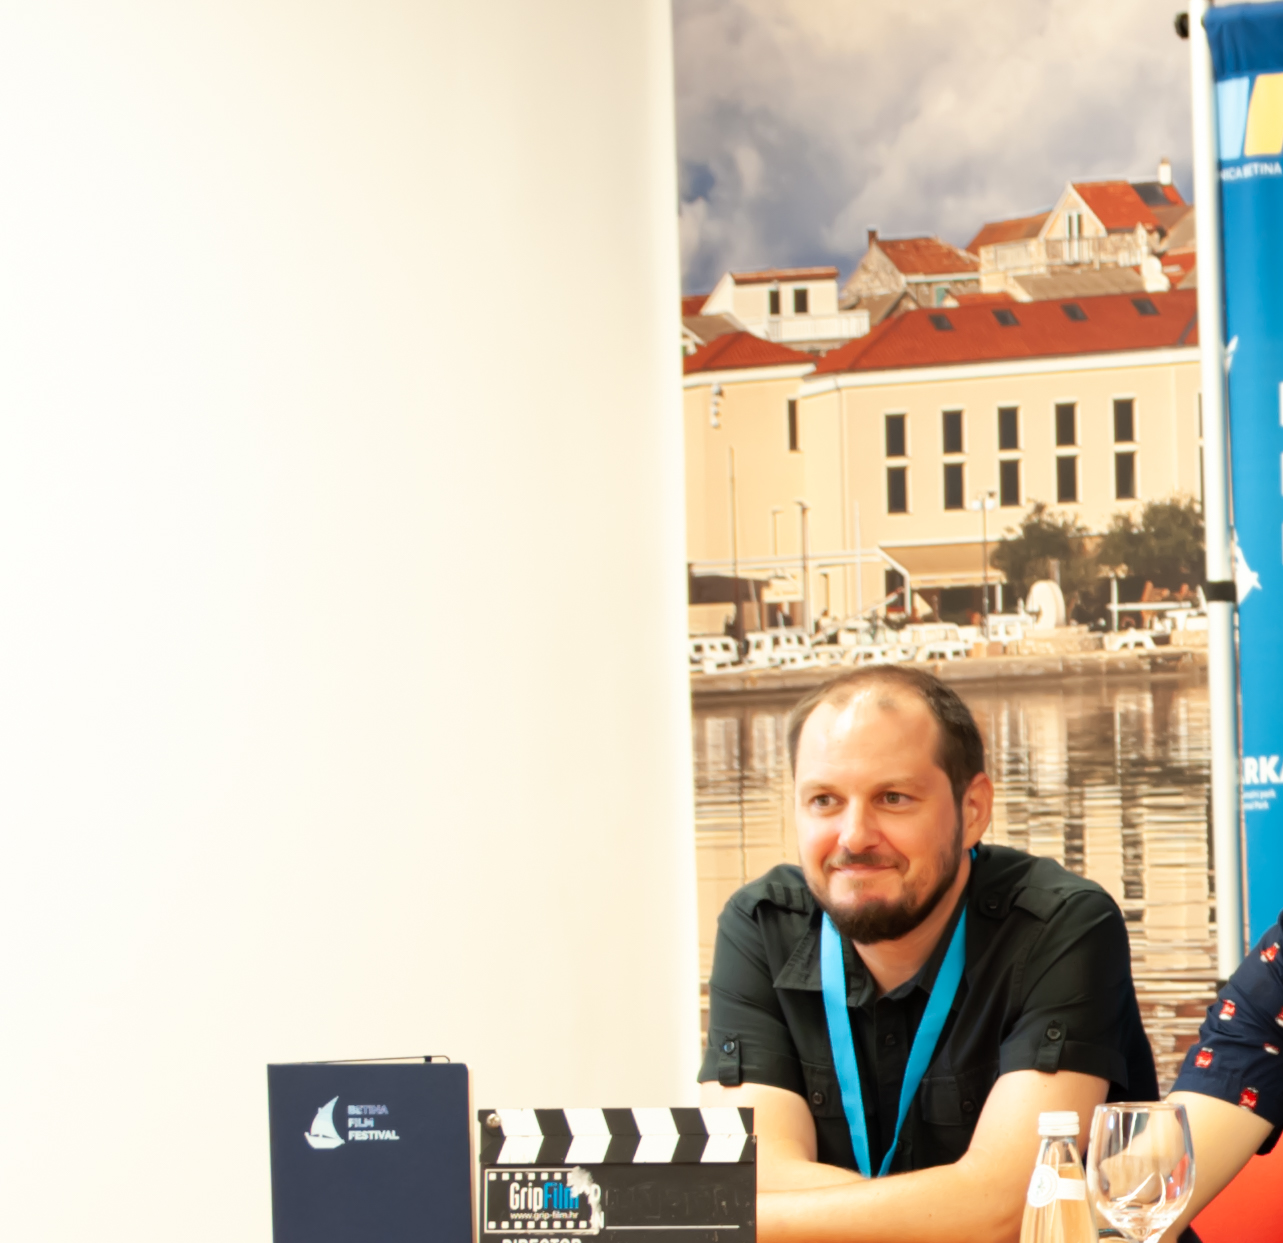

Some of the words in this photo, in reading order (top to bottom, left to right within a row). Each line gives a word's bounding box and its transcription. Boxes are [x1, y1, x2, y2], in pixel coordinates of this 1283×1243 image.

[347, 1104, 389, 1115] BETINA
[348, 1117, 375, 1128] FILM
[348, 1129, 400, 1141] FESTIVAL
